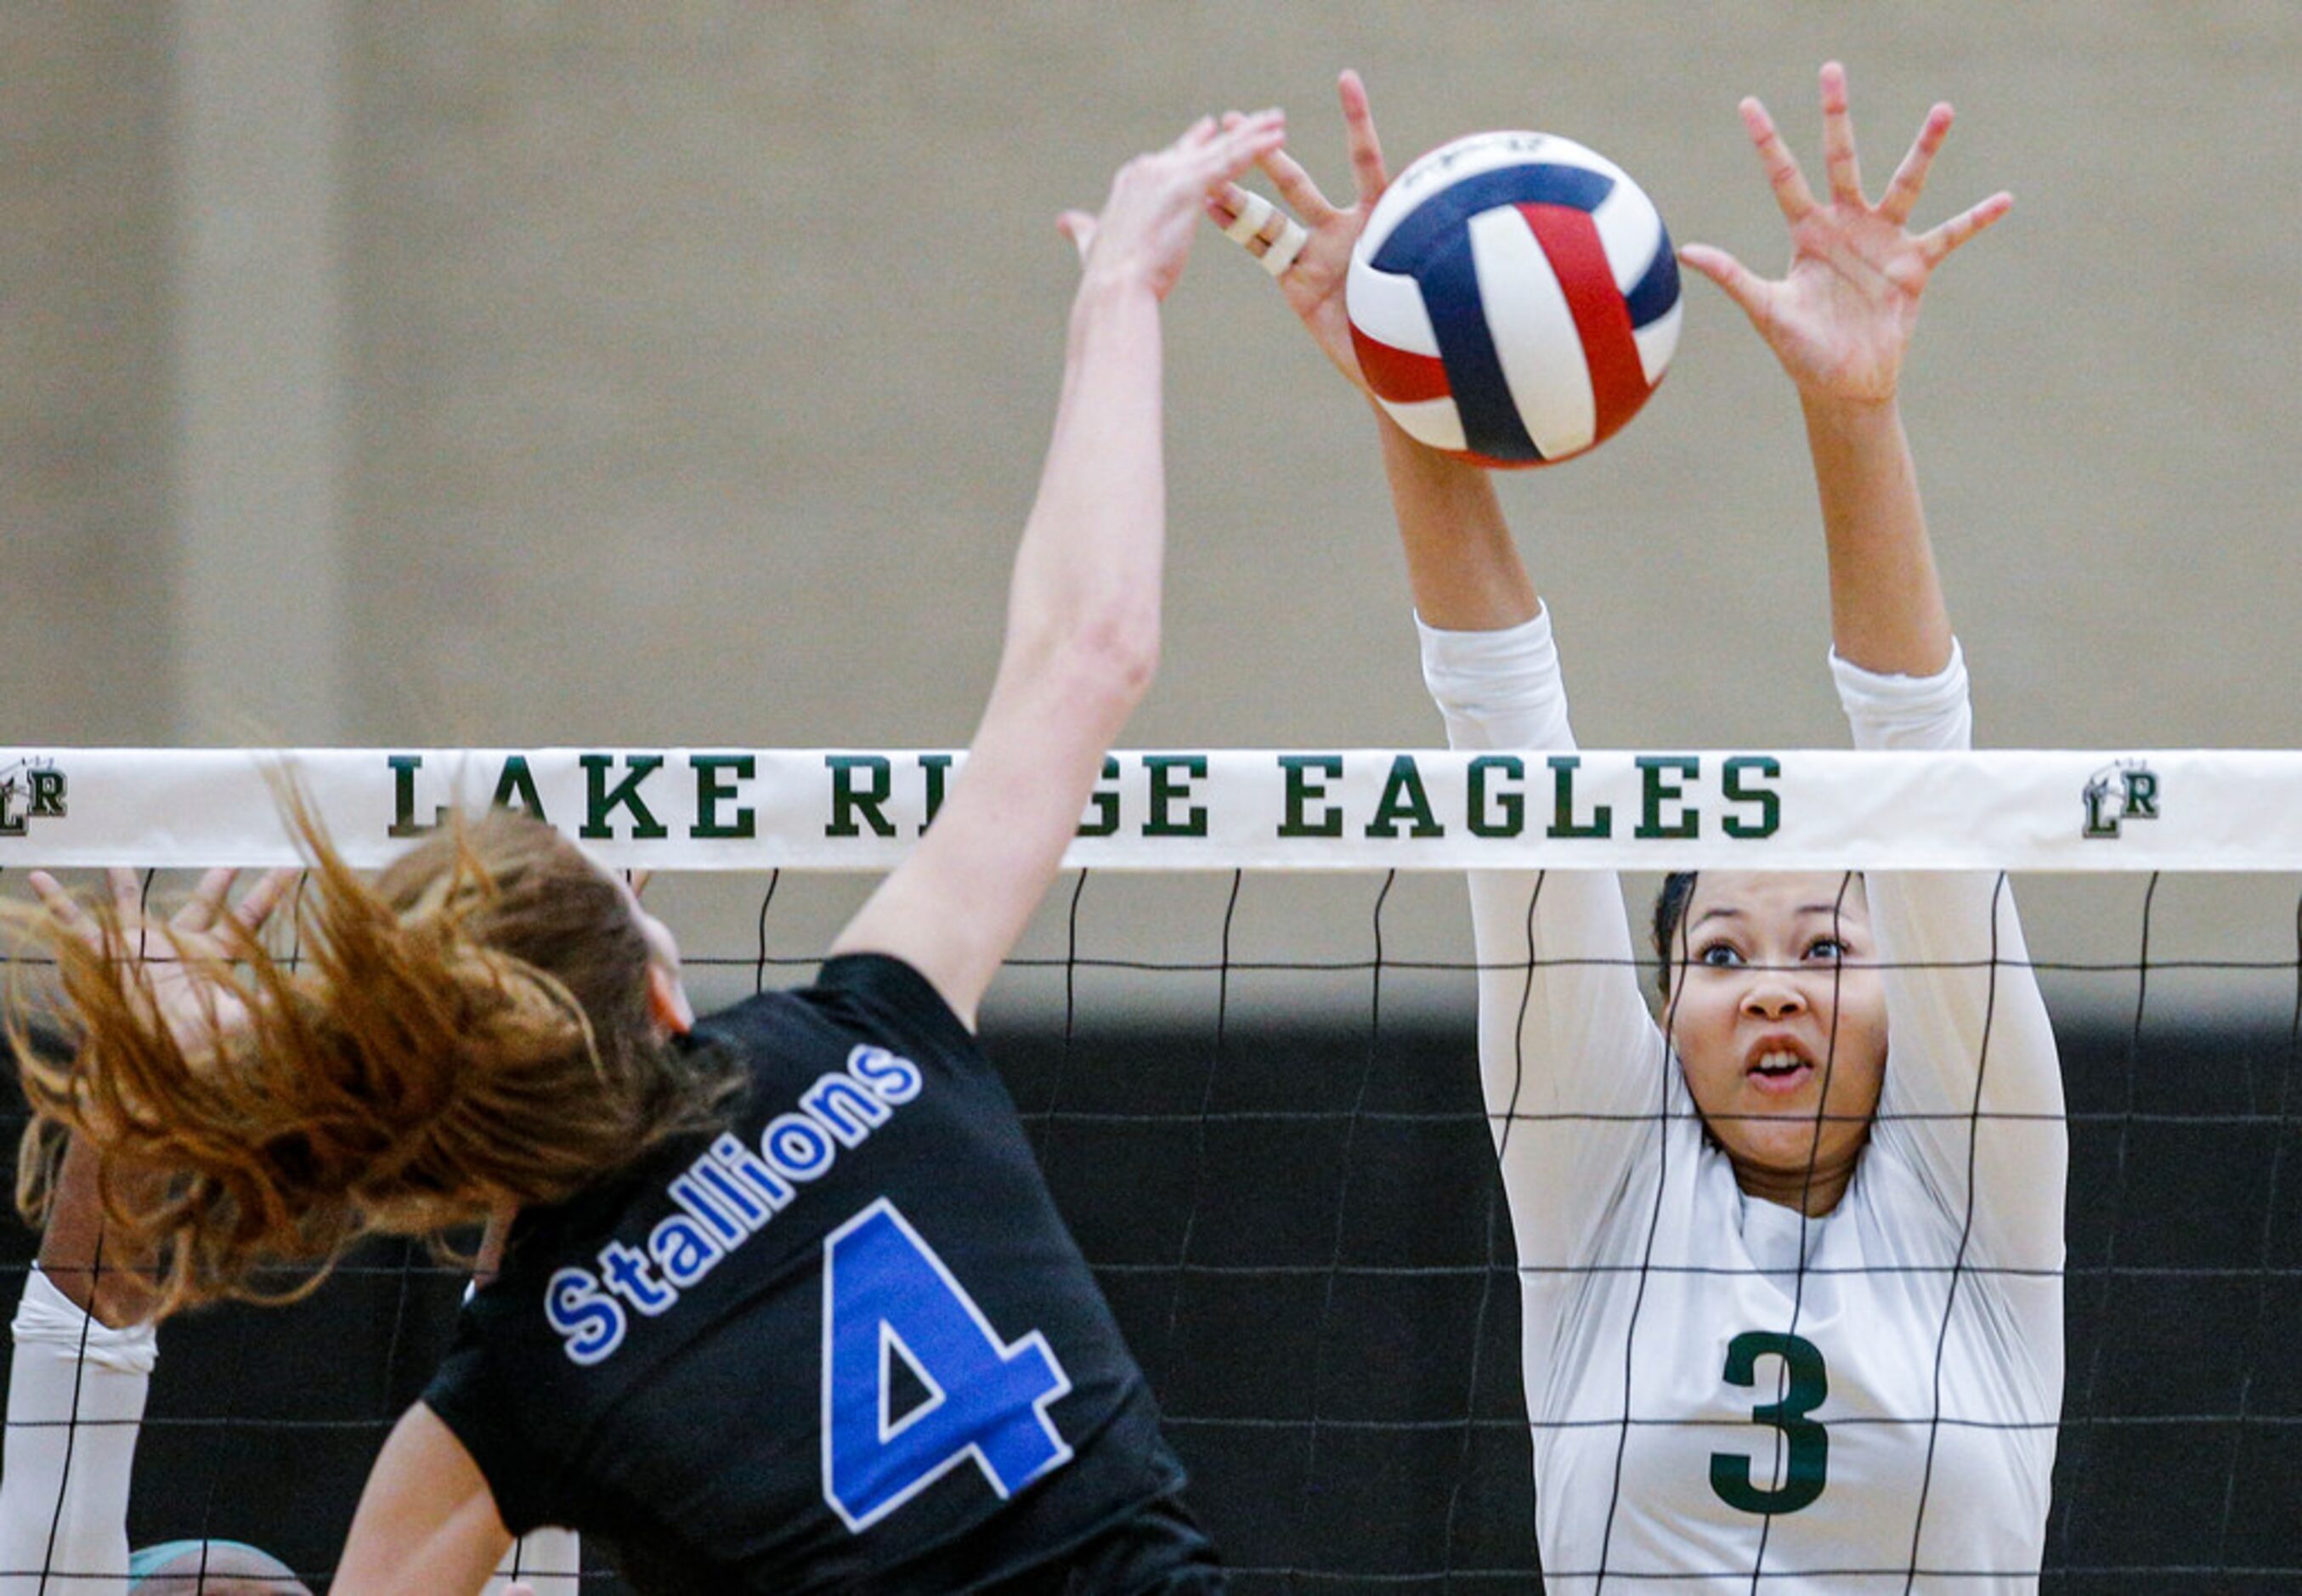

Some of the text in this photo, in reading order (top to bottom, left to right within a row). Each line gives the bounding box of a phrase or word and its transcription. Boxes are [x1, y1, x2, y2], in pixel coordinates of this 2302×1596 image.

[387, 755, 1781, 839] LAKE RIGE EAGLES
[544, 1043, 923, 1364] Stallions
[821, 1196, 1074, 1534] 4
[1710, 1330, 1829, 1516] 3
